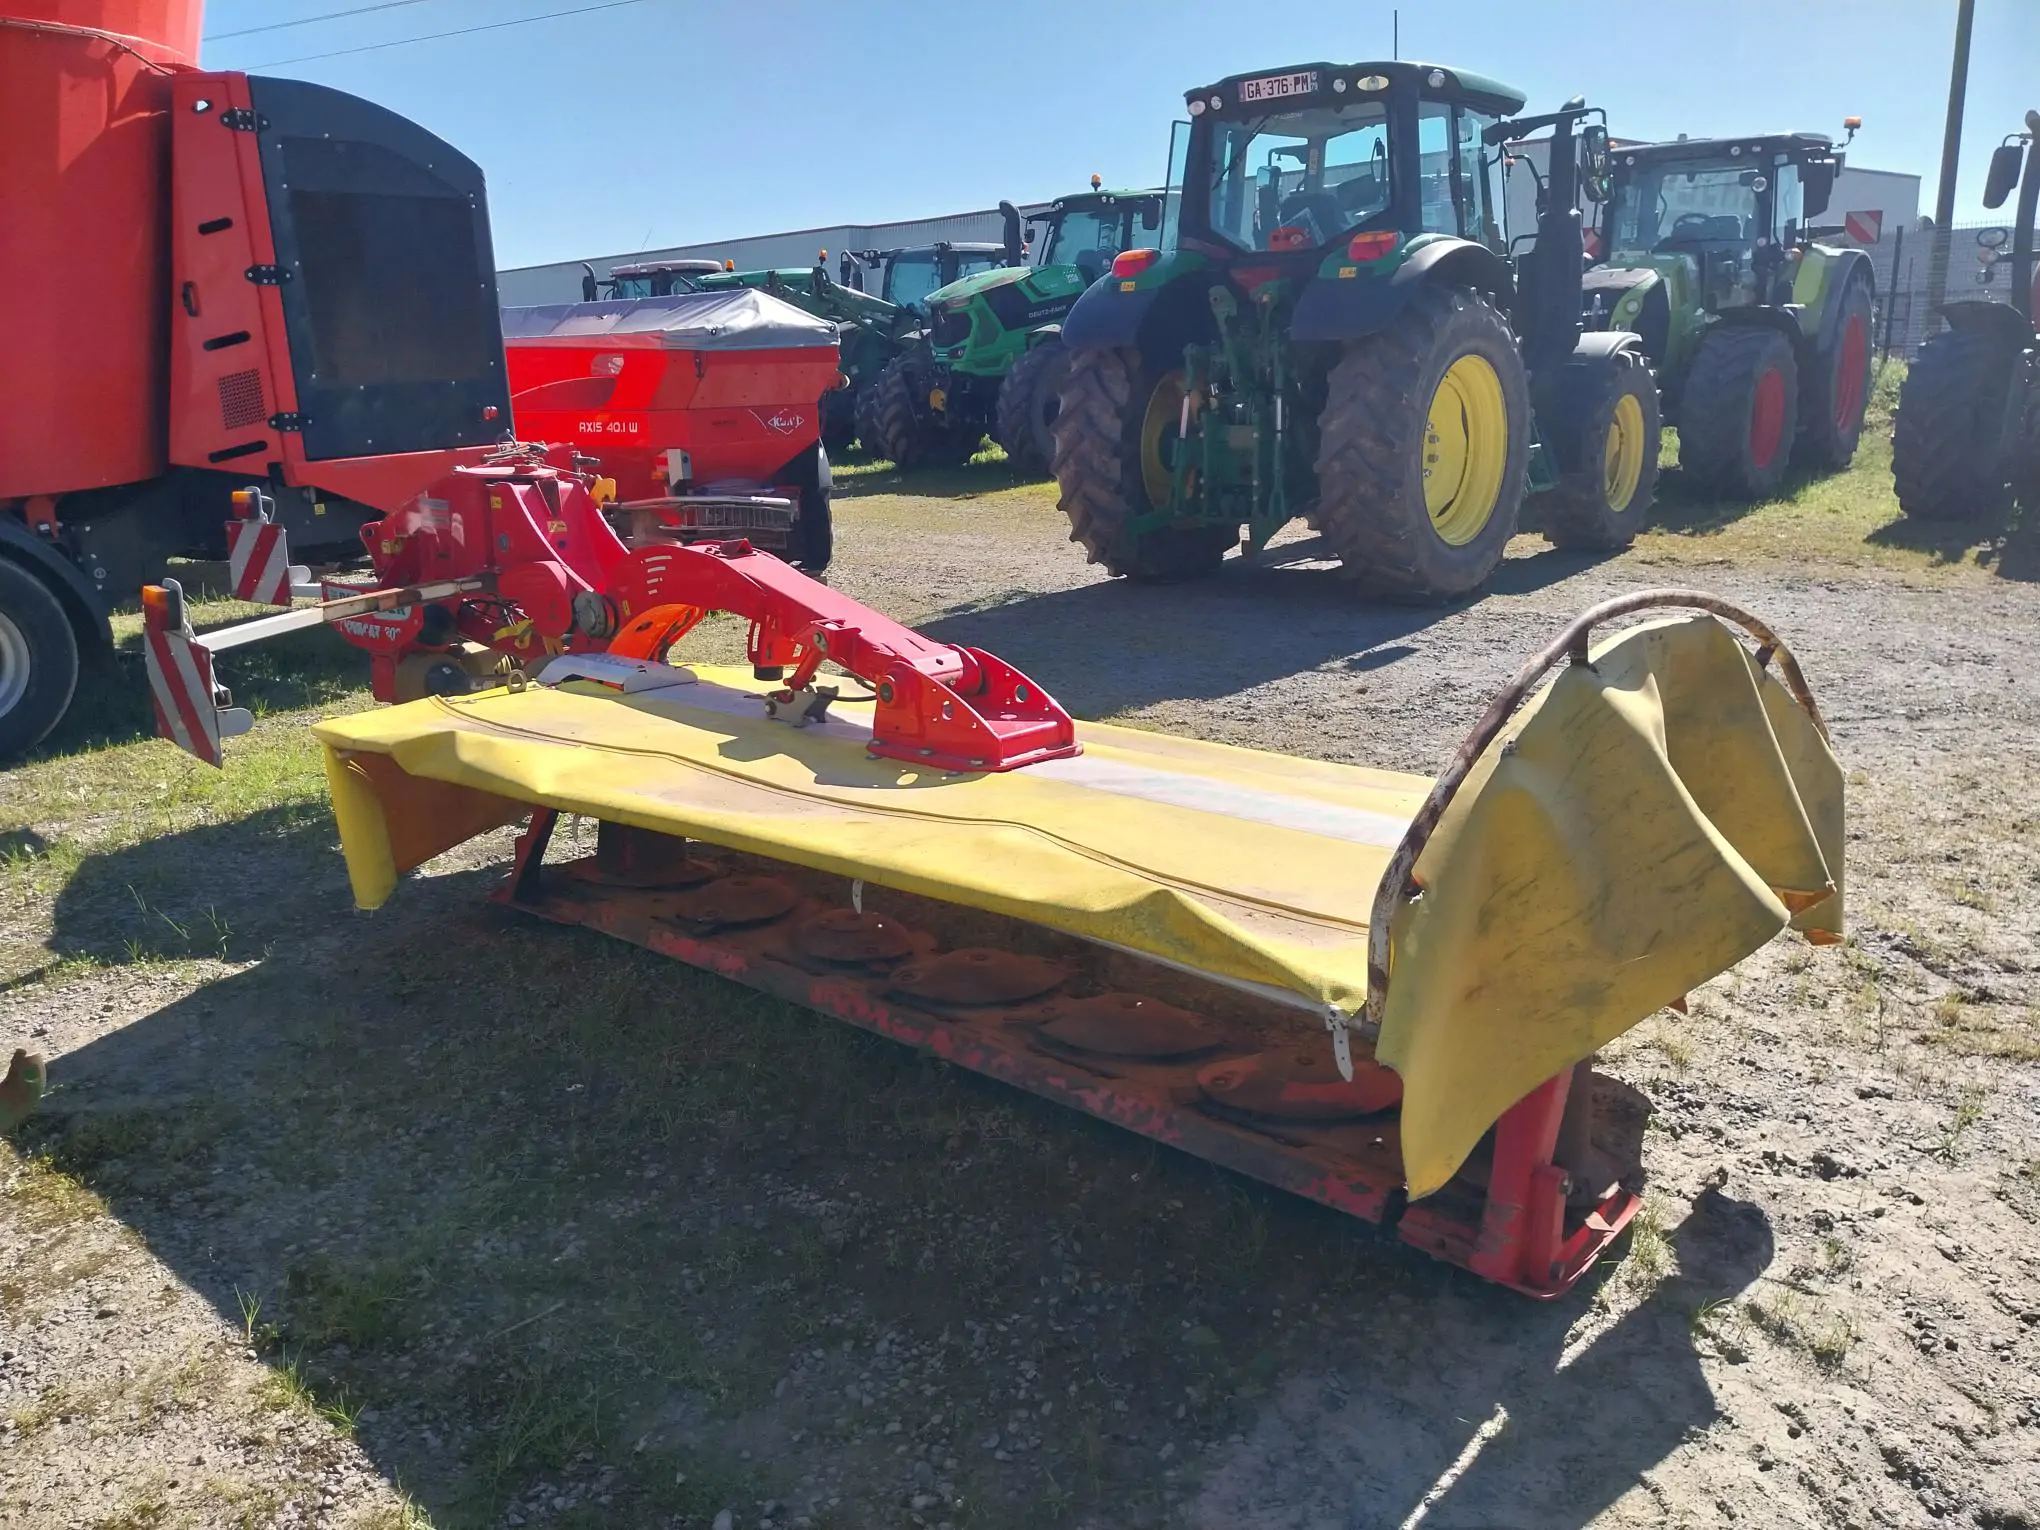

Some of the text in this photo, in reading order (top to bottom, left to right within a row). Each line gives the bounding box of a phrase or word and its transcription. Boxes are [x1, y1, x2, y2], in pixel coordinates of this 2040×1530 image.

[1247, 74, 1309, 99] GA-376-PM
[579, 421, 638, 433] AXIS 40.1 W
